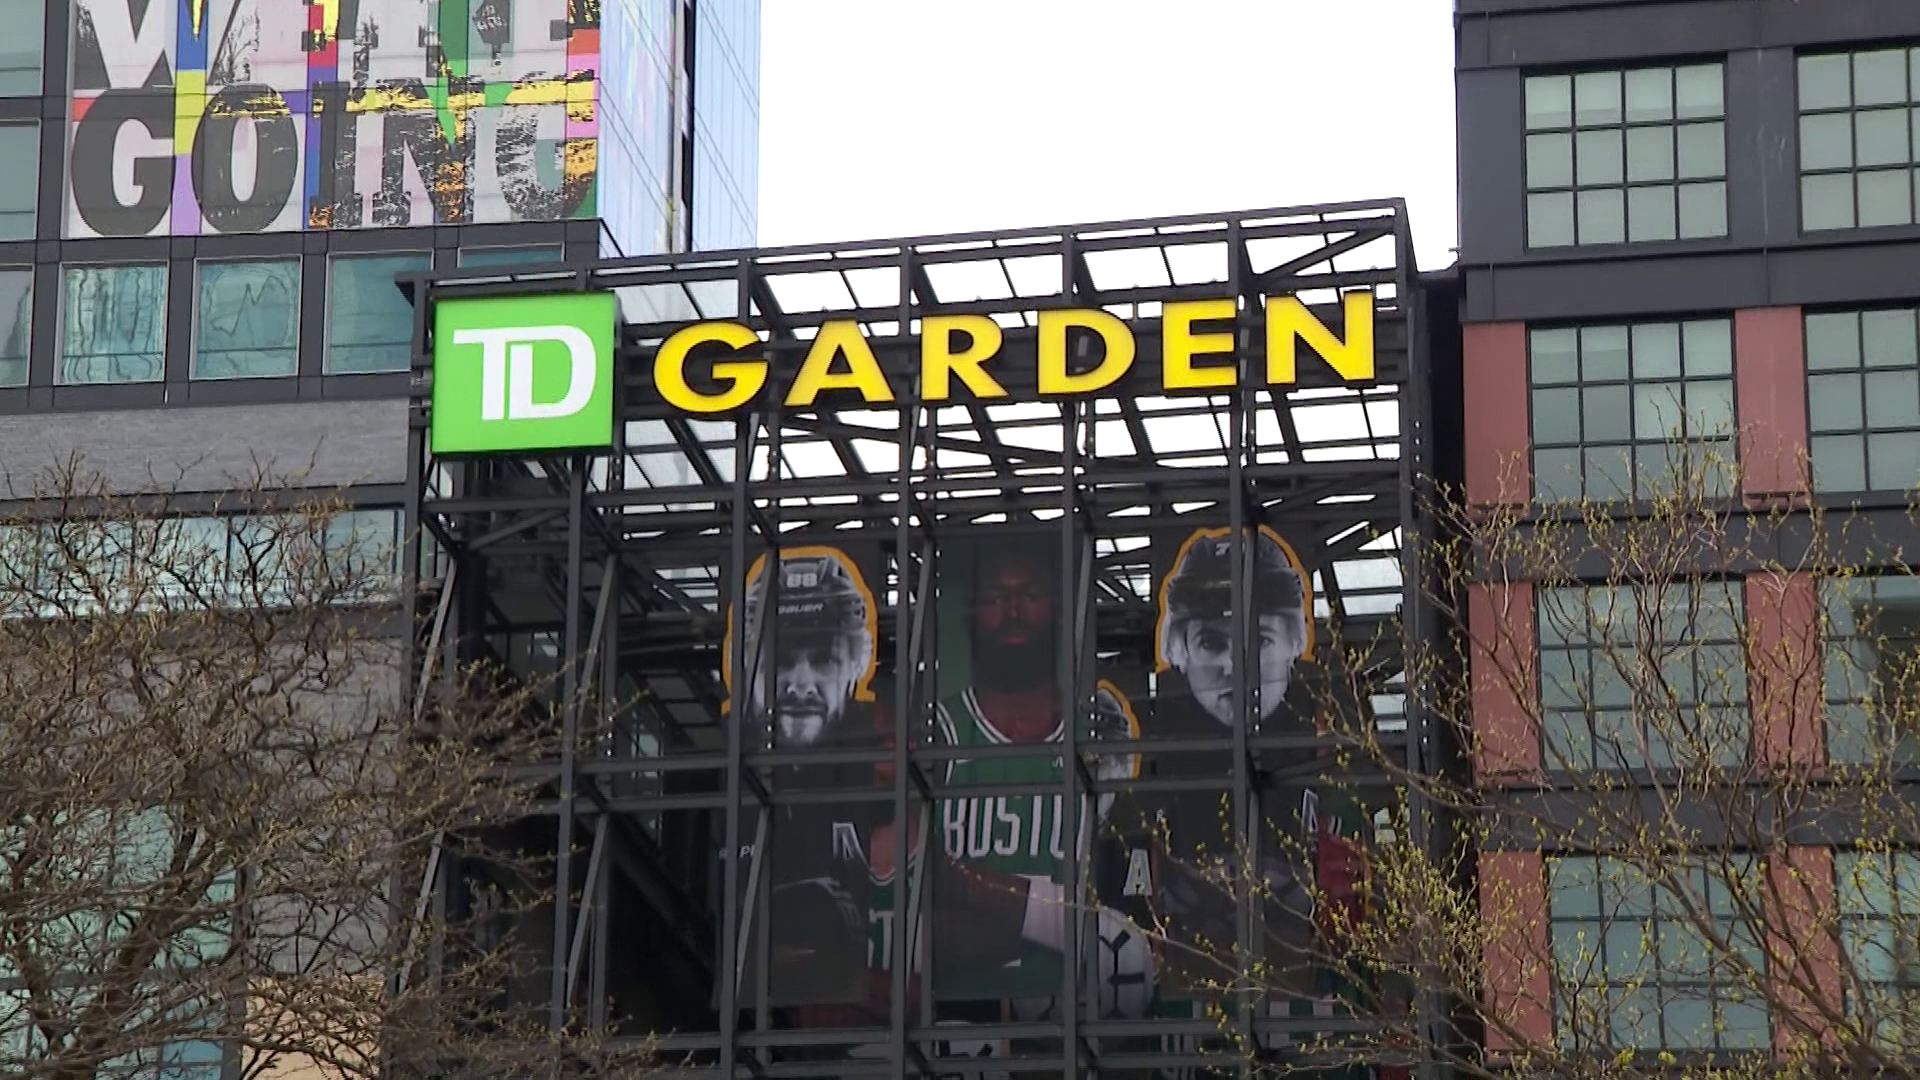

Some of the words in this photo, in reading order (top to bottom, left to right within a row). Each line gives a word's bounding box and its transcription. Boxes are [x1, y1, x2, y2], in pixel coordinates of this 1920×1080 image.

[71, 70, 598, 237] GOING
[453, 324, 597, 421] TD
[655, 293, 1373, 412] GARDEN
[1122, 848, 1153, 897] A
